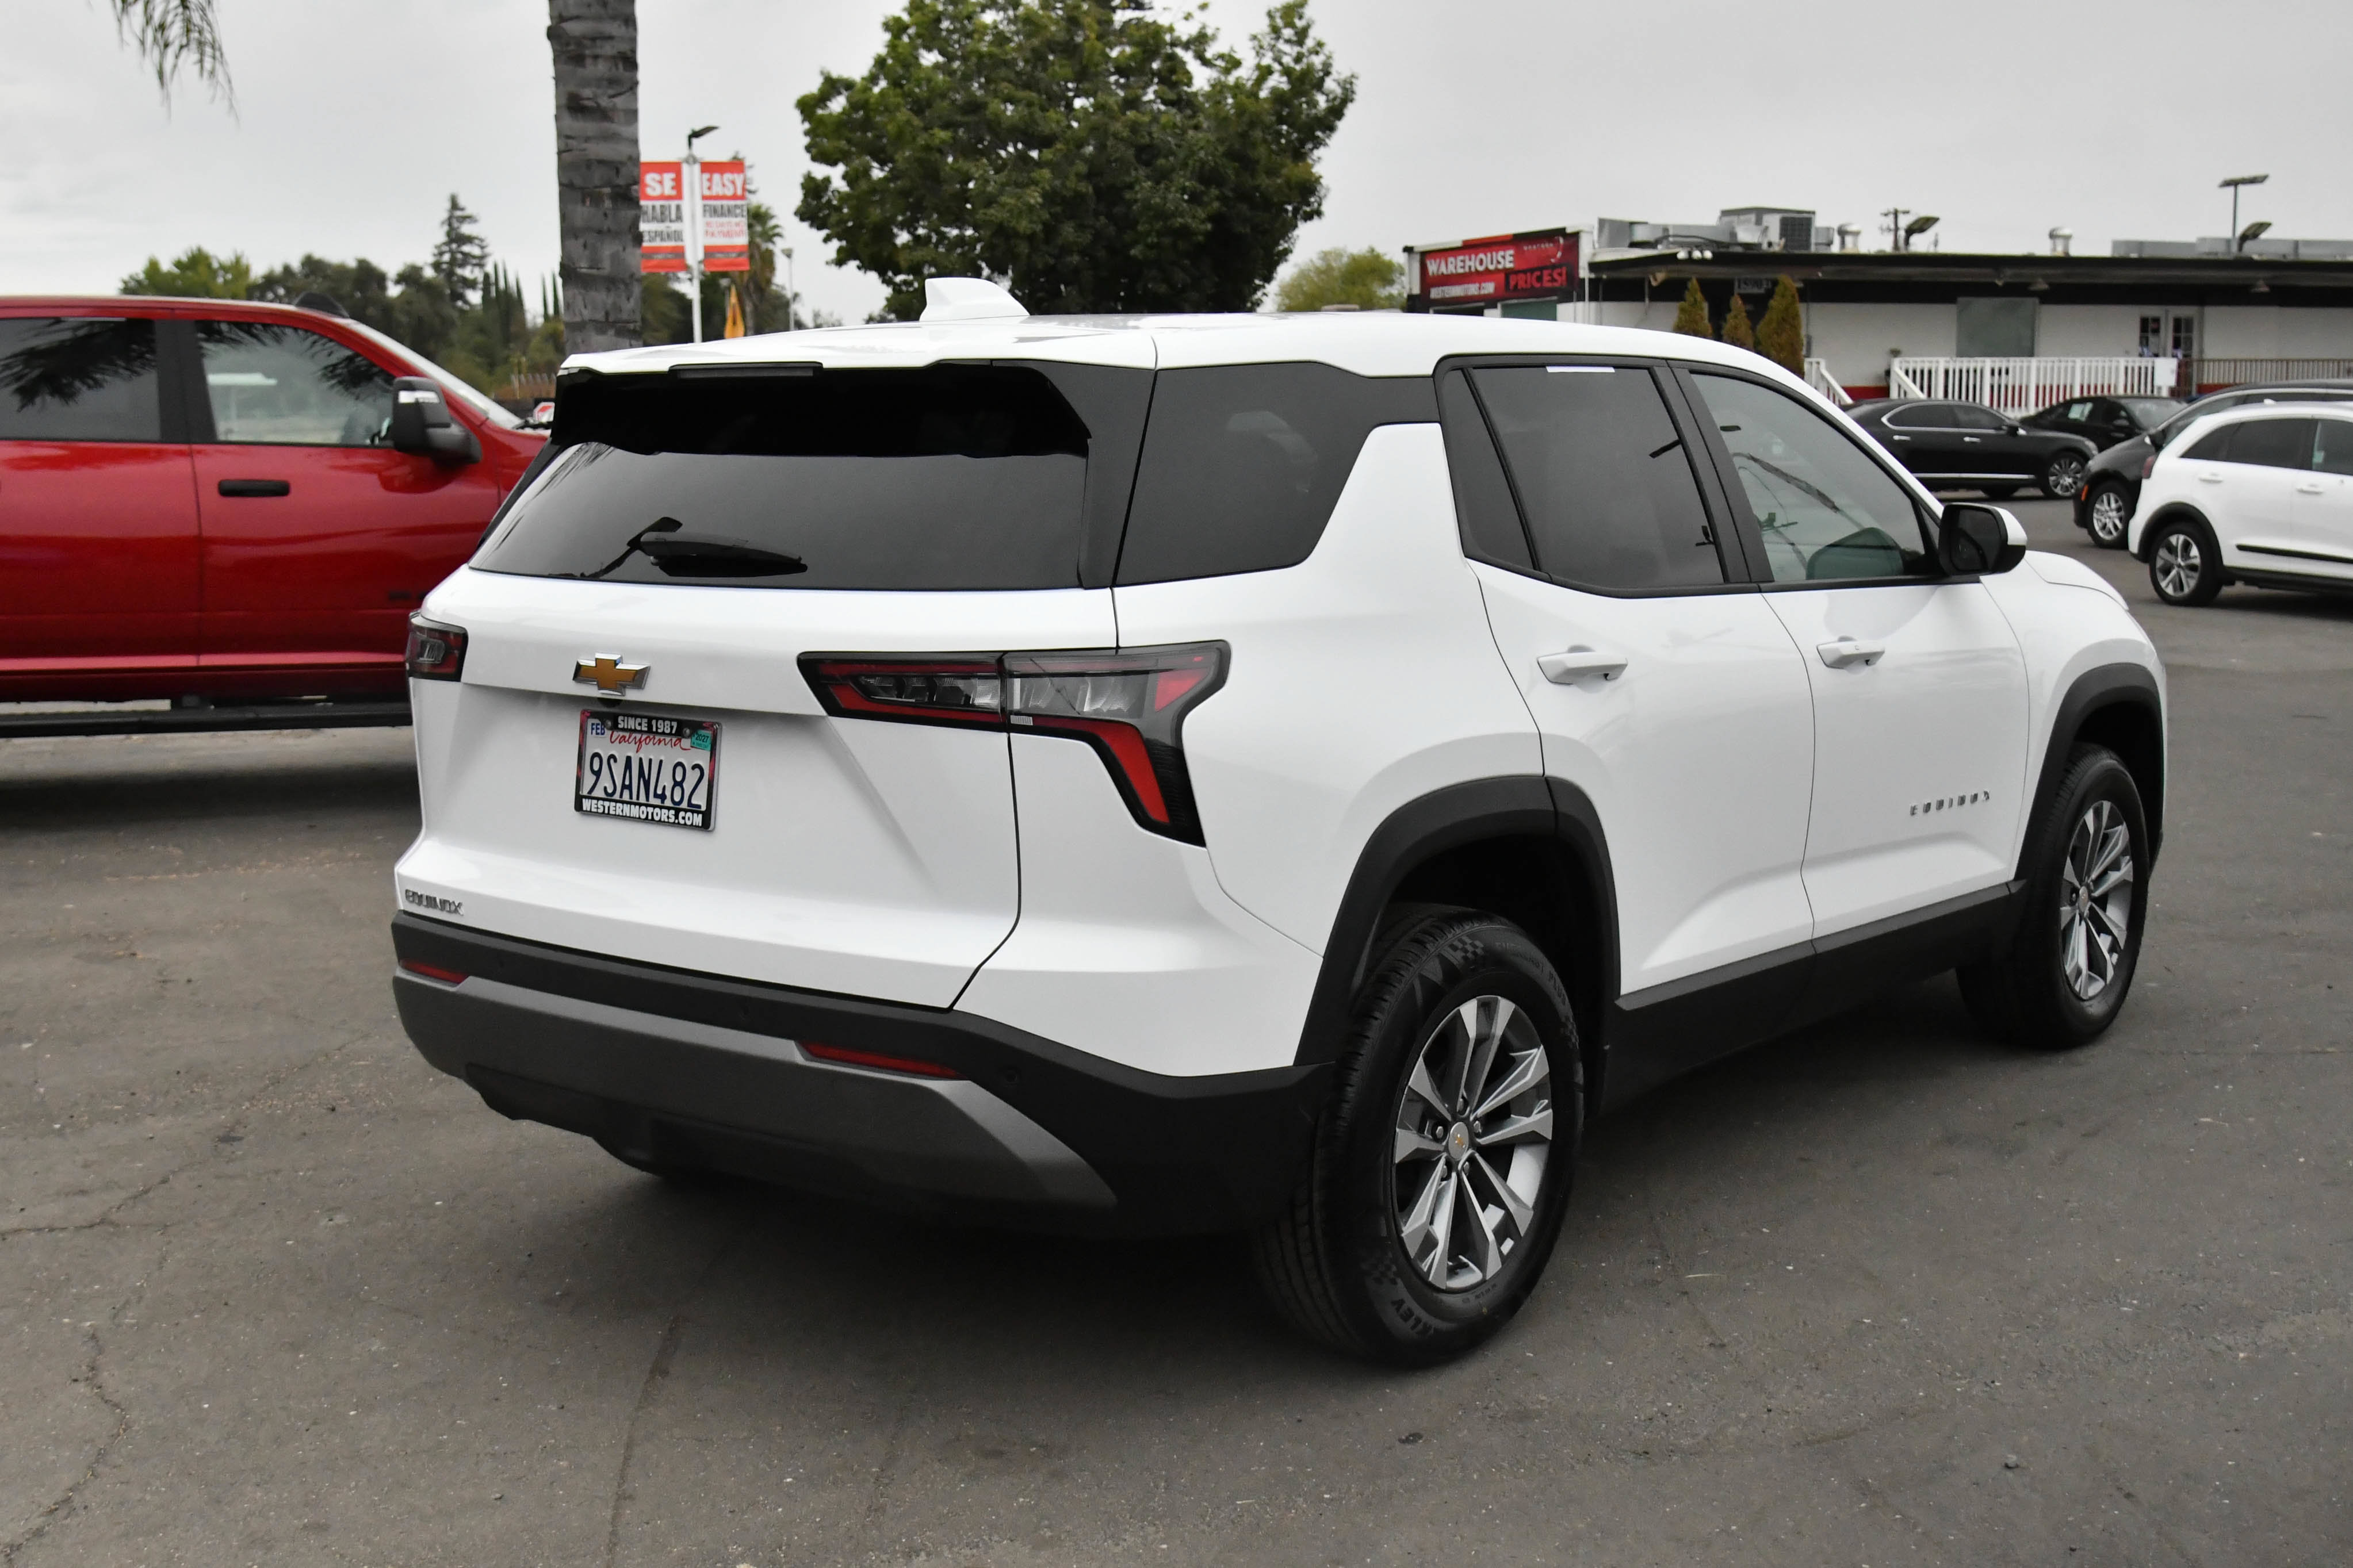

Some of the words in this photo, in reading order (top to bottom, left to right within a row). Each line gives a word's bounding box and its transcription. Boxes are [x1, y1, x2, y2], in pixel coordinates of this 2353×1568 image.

[644, 172, 676, 196] SE
[702, 173, 744, 195] EASY
[703, 204, 746, 218] FINANCE
[1426, 249, 1514, 276] WAREHOUSE
[1509, 266, 1567, 290] PRICES!
[591, 722, 606, 735] FEB
[618, 716, 648, 730] SINCE
[651, 720, 678, 734] 1987
[610, 730, 691, 753] California
[695, 734, 709, 743] 2027
[587, 752, 705, 809] 9SAN482
[582, 798, 702, 827] WESTERNMOTORS.COM
